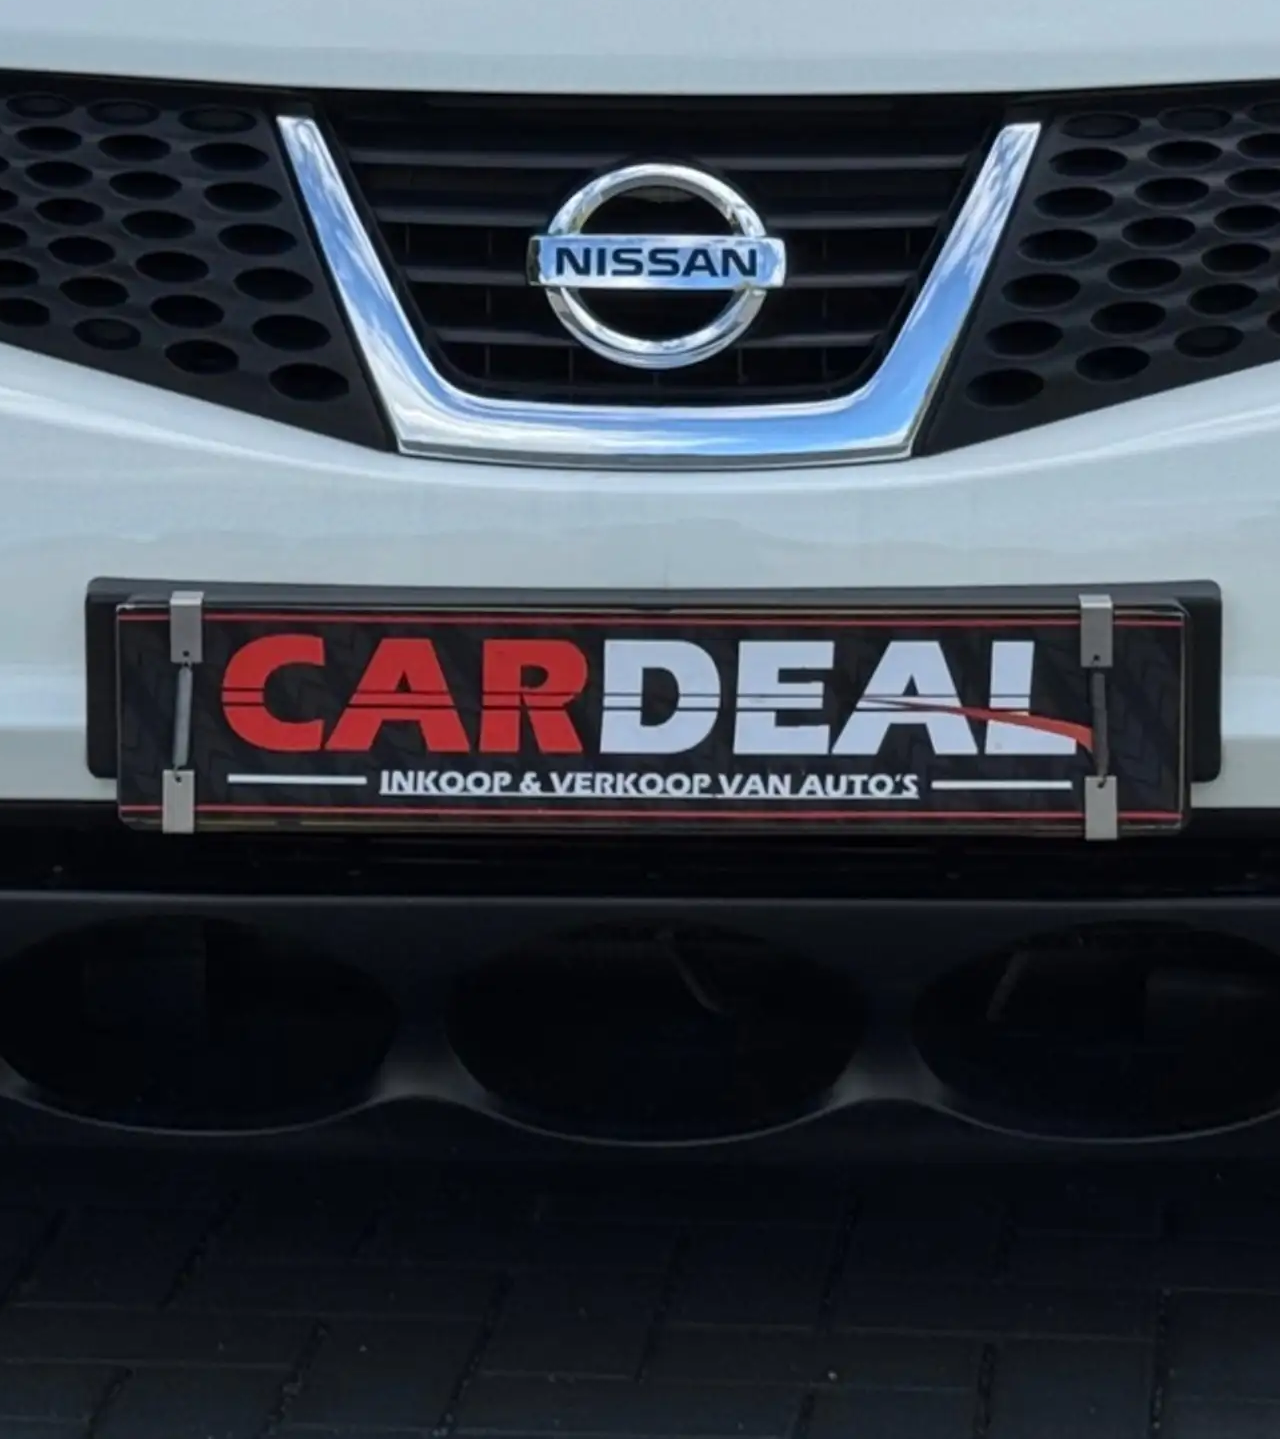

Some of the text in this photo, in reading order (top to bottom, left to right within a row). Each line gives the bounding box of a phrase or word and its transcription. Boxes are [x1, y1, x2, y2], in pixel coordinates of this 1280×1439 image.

[555, 247, 758, 278] NISSAN
[222, 634, 1078, 755] CARDEAL
[380, 770, 920, 798] INKOOP & VERKOOP VAN AUTO'S
